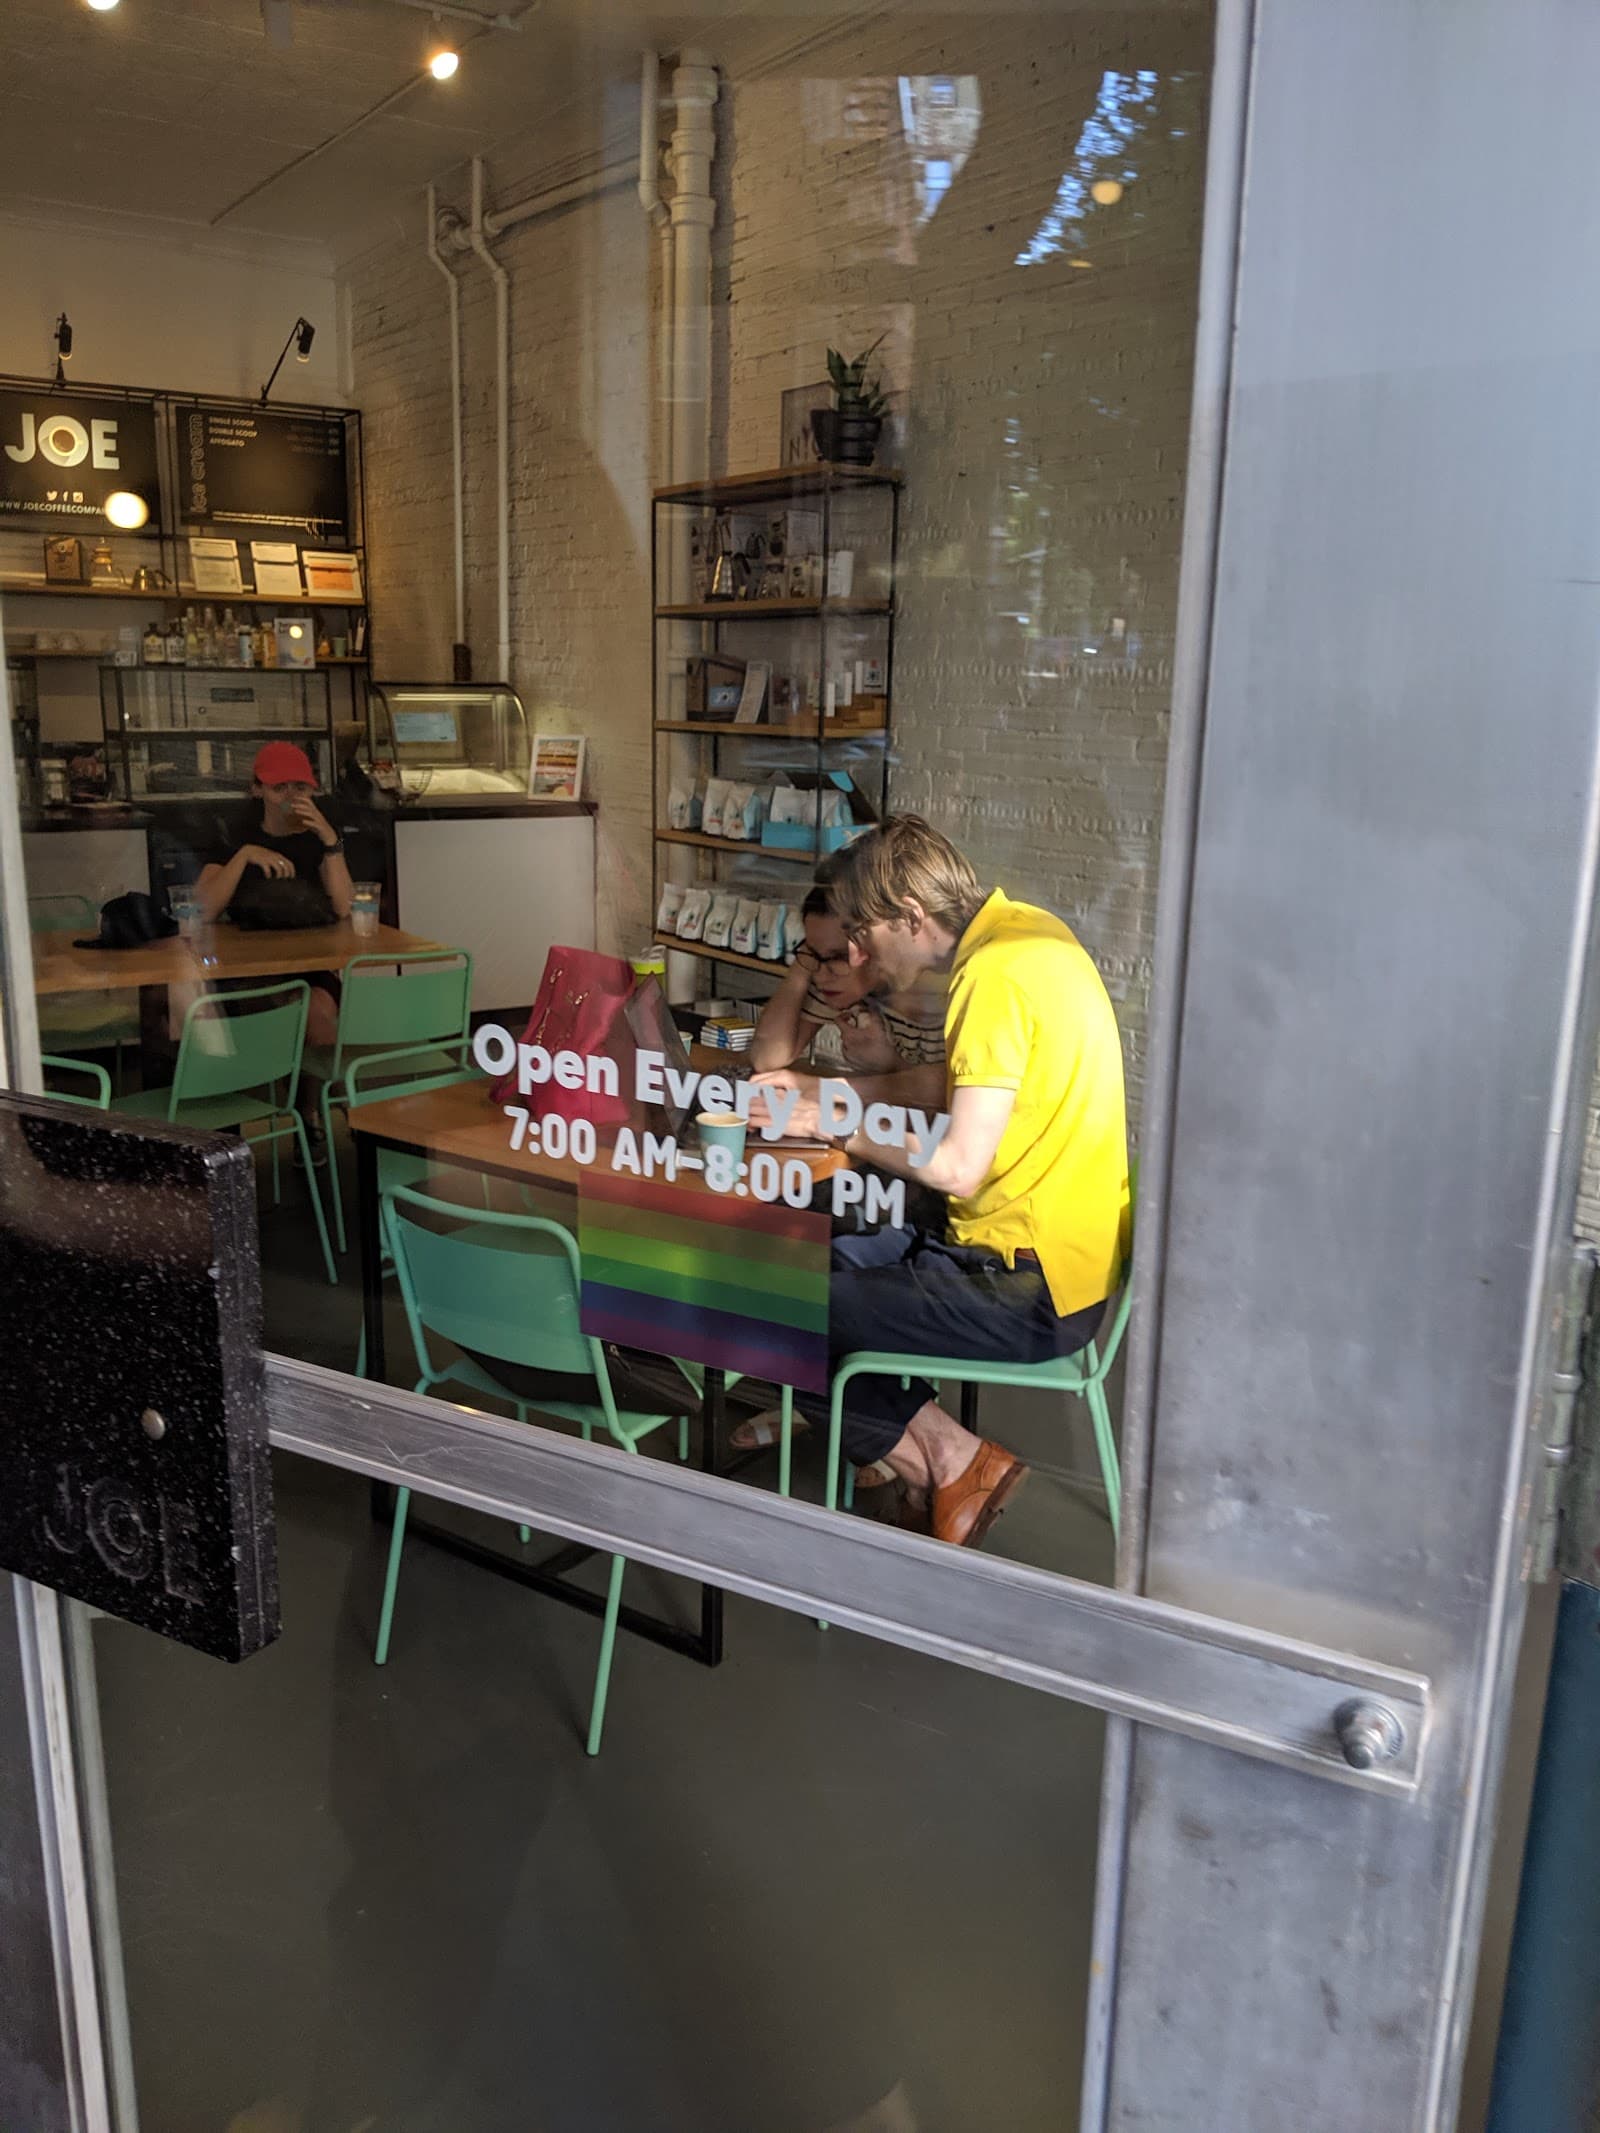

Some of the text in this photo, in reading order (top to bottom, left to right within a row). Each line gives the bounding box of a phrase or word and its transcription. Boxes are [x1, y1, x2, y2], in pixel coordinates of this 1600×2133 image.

[4, 412, 121, 471] JOE
[235, 429, 258, 438] SCOOP
[472, 1023, 951, 1168] Open Every Day
[503, 1106, 597, 1166] 7:00
[832, 1169, 906, 1230] PM
